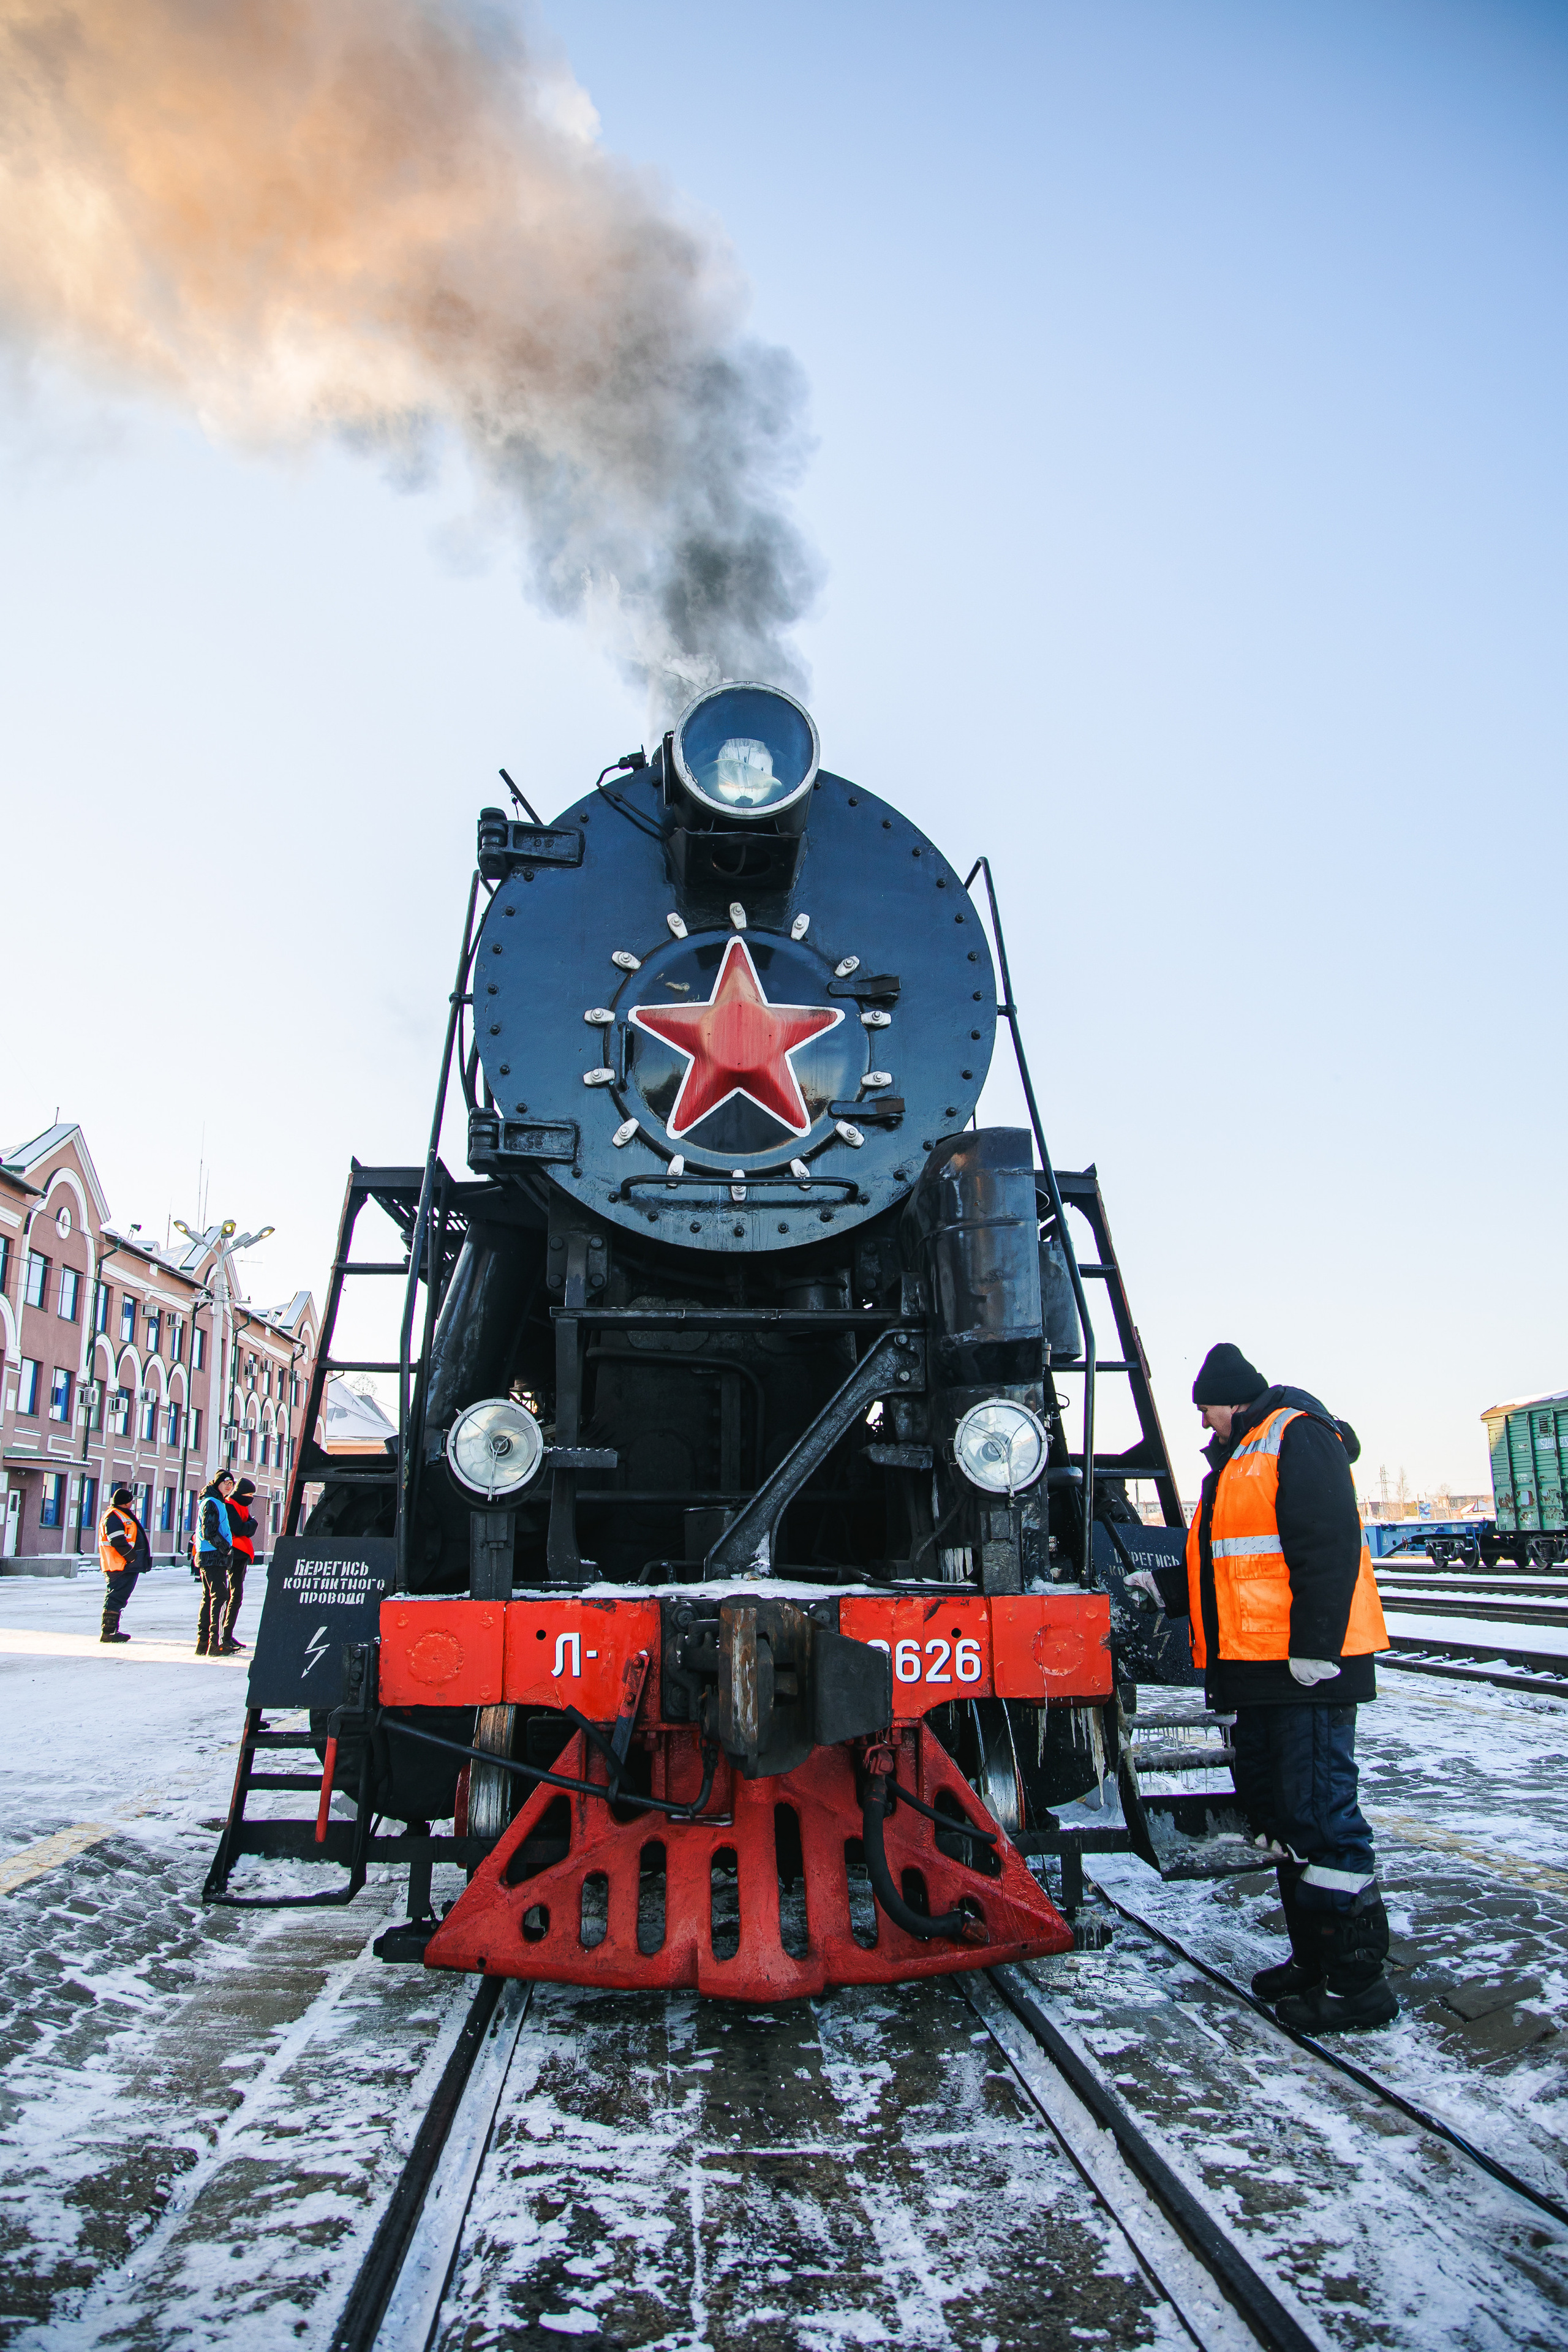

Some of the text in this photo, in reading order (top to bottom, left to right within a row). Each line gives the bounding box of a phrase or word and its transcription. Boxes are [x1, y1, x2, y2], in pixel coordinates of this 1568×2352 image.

[294, 1559, 369, 1577] БЕРЕГИСЬ
[283, 1577, 385, 1591] КОНТАКТНОГО
[299, 1592, 365, 1604] ПРОВОДА
[866, 1638, 982, 1684] 626
